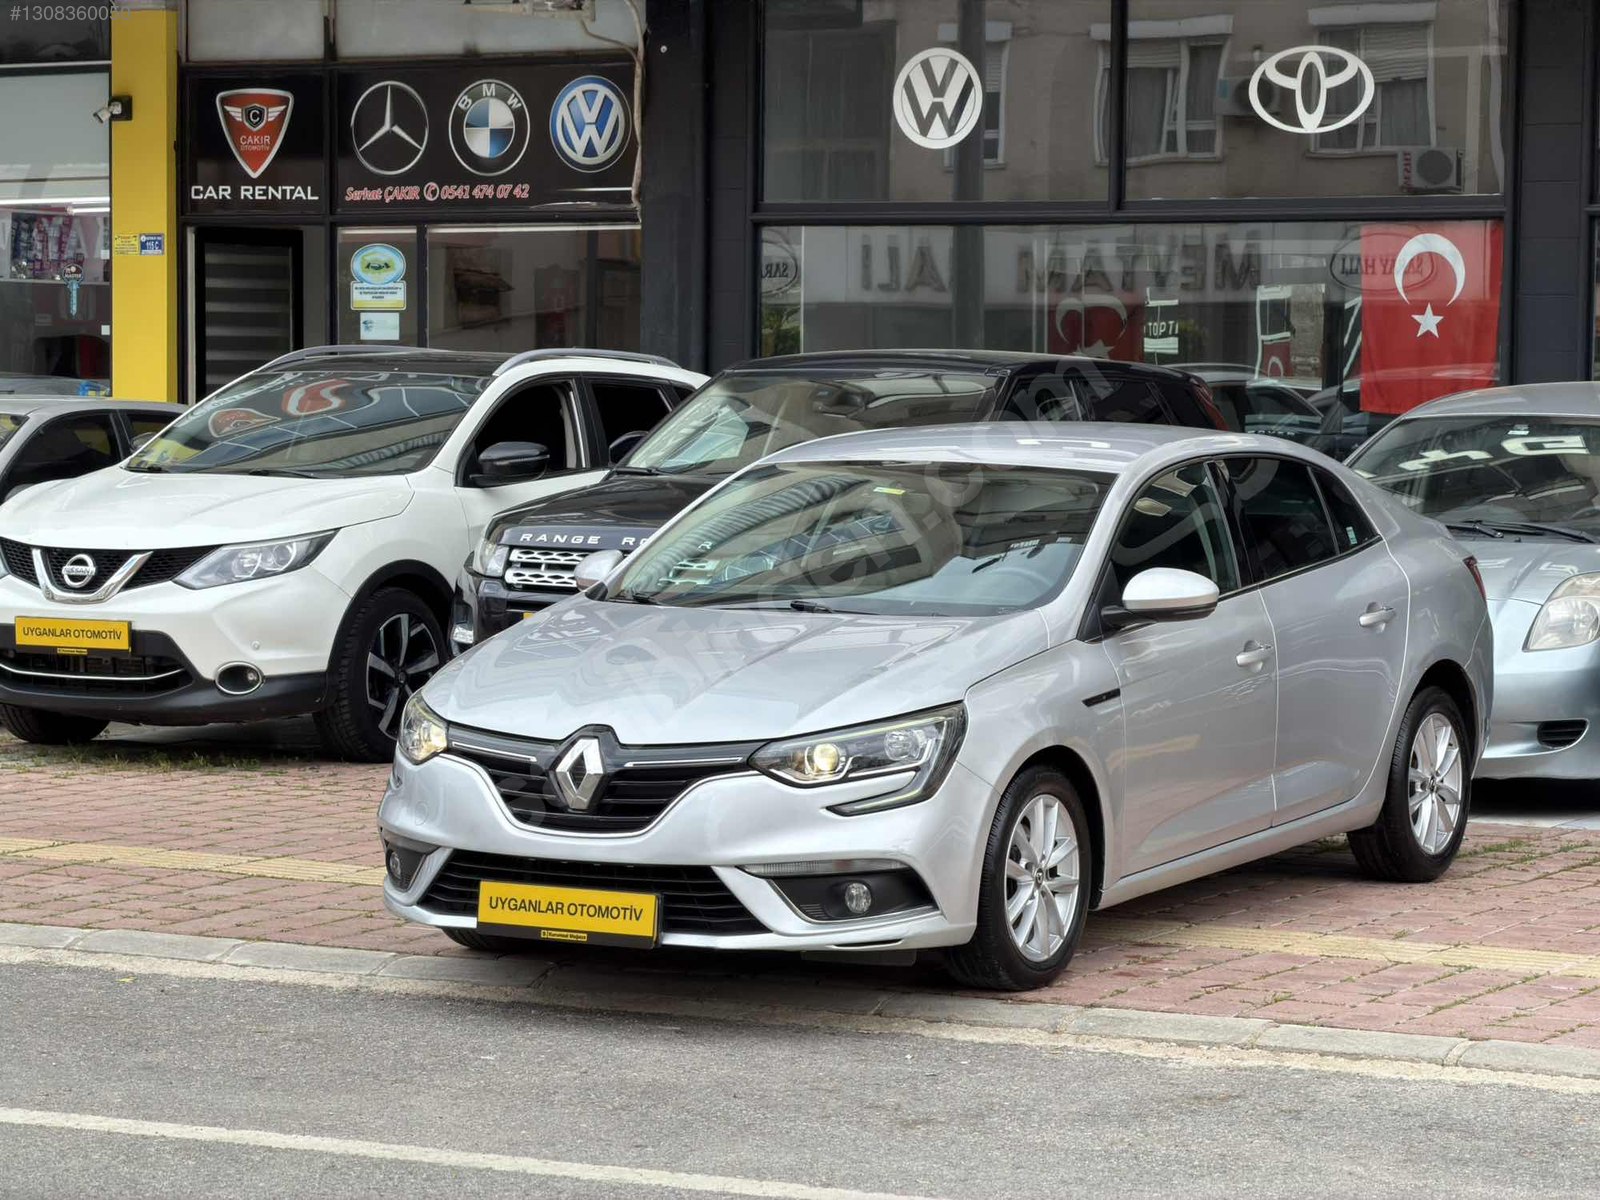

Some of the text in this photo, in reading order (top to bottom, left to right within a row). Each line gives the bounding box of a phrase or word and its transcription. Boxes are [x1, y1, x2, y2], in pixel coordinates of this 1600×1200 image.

[191, 186, 319, 200] CAR RENTAL
[384, 185, 420, 203] ÇAKIR
[440, 185, 470, 199] 0541
[472, 184, 494, 198] 474
[496, 184, 513, 198] 07
[513, 183, 530, 198] 42
[520, 533, 601, 545] RANGE
[22, 626, 122, 640] UYGANLAR OTOMOTİV
[489, 895, 643, 922] UYGANLAR OTOMOTİV
